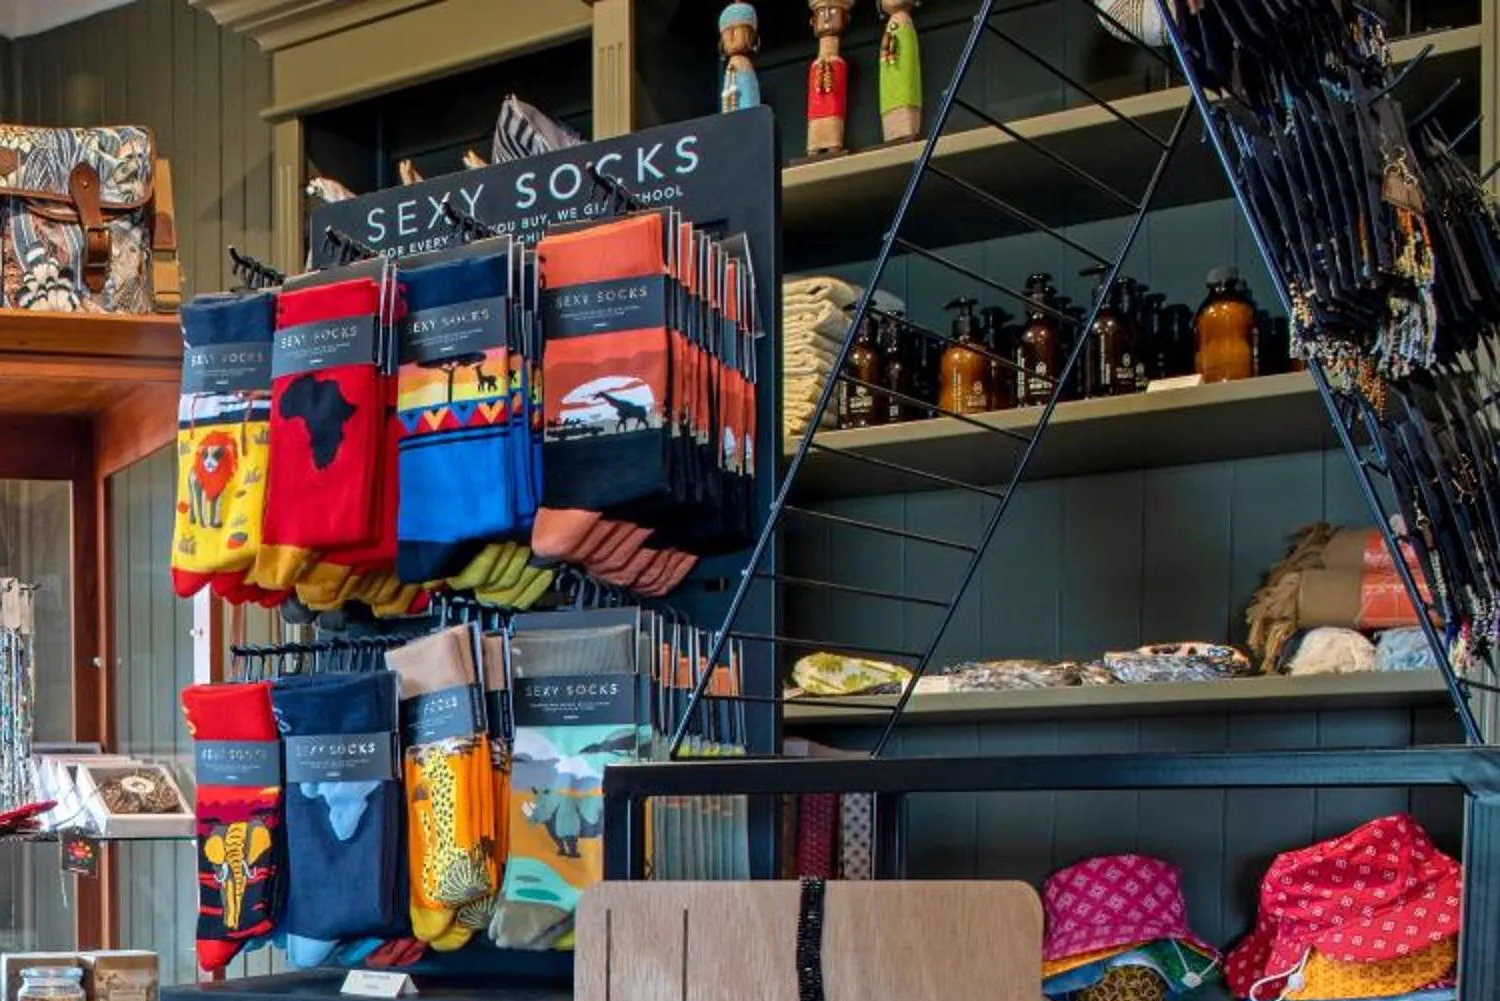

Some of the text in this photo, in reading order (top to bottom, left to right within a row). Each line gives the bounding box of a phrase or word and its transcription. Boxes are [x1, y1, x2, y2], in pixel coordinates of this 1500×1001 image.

[366, 135, 699, 243] SEXY SOCKS
[409, 236, 449, 253] EVERY
[557, 207, 577, 220] WE
[566, 683, 619, 696] SOCKS
